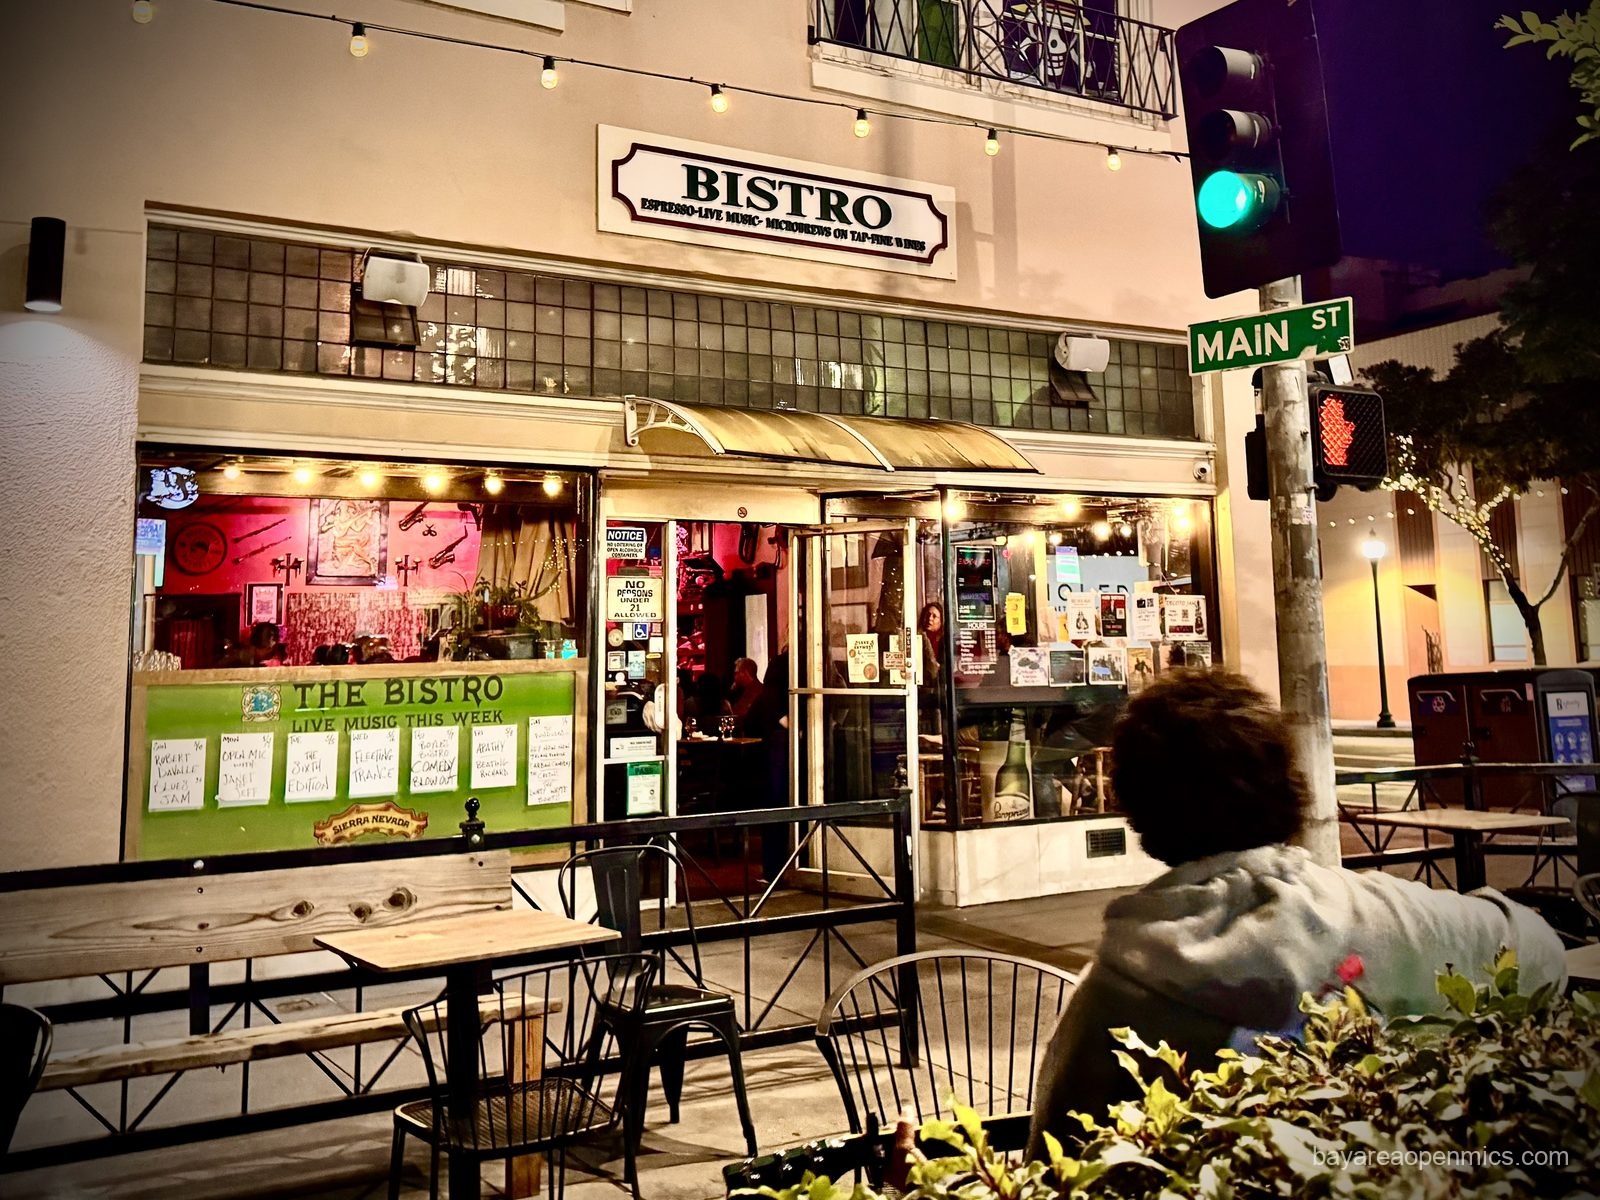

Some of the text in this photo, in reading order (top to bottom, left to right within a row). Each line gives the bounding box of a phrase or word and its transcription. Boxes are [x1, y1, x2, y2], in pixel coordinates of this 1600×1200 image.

[681, 163, 892, 230] BISTRO
[833, 228, 848, 239] ON
[1198, 306, 1341, 364] MAIN ST
[607, 531, 643, 541] NOTICE
[625, 580, 645, 588] NO
[293, 675, 504, 713] THE BISTRO
[292, 710, 503, 734] LIVE MUSIC THIS WEEK
[352, 732, 369, 741] WED
[222, 749, 267, 761] OPEN MIC
[304, 750, 318, 760] THE
[476, 742, 505, 754] APATHY
[291, 760, 321, 775] SIXTH
[353, 765, 394, 783] TRANCE
[411, 757, 456, 777] COMEDY
[288, 776, 329, 793] EDITION
[160, 791, 191, 805] JAM
[332, 815, 410, 835] SIERRA NEVADA
